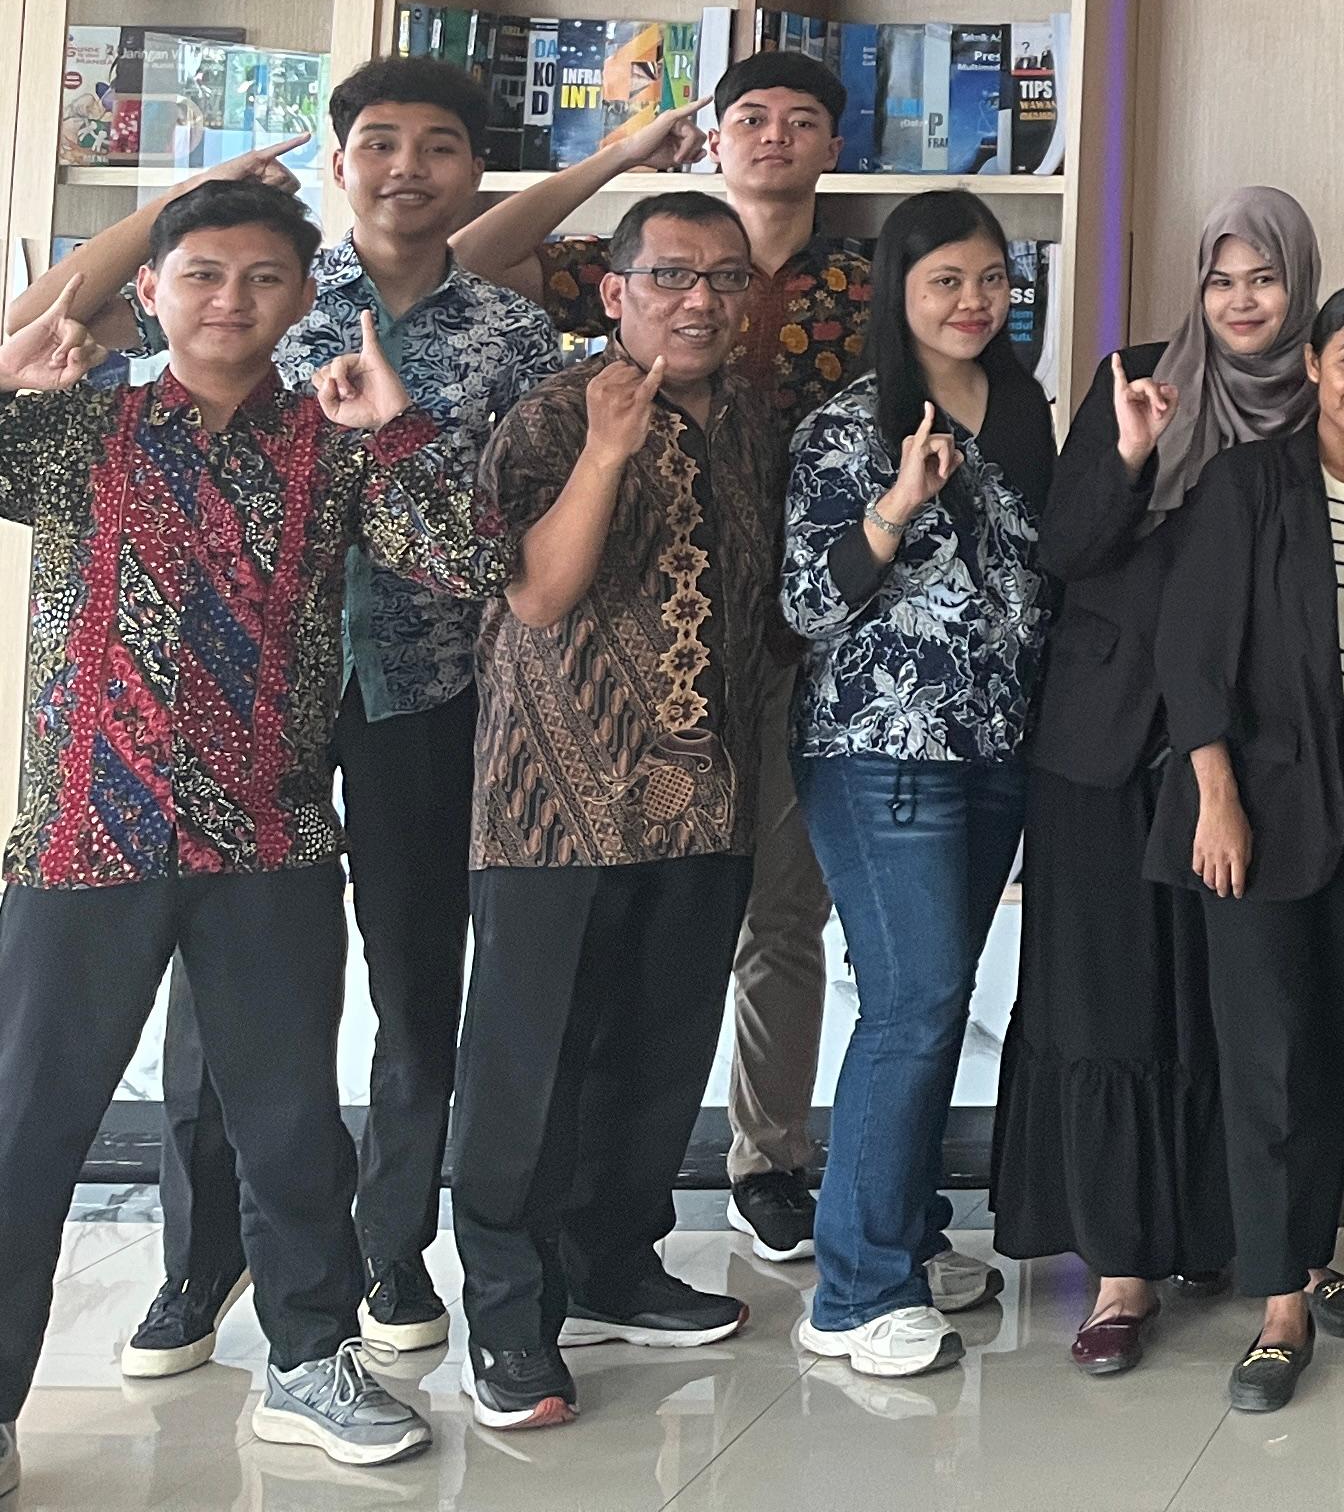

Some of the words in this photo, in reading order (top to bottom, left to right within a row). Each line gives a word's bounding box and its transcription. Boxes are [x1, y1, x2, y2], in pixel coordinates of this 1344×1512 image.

[120, 47, 169, 62] Jaringan
[562, 67, 602, 85] INFRA
[560, 85, 601, 109] INT
[1020, 80, 1053, 100] TIPS
